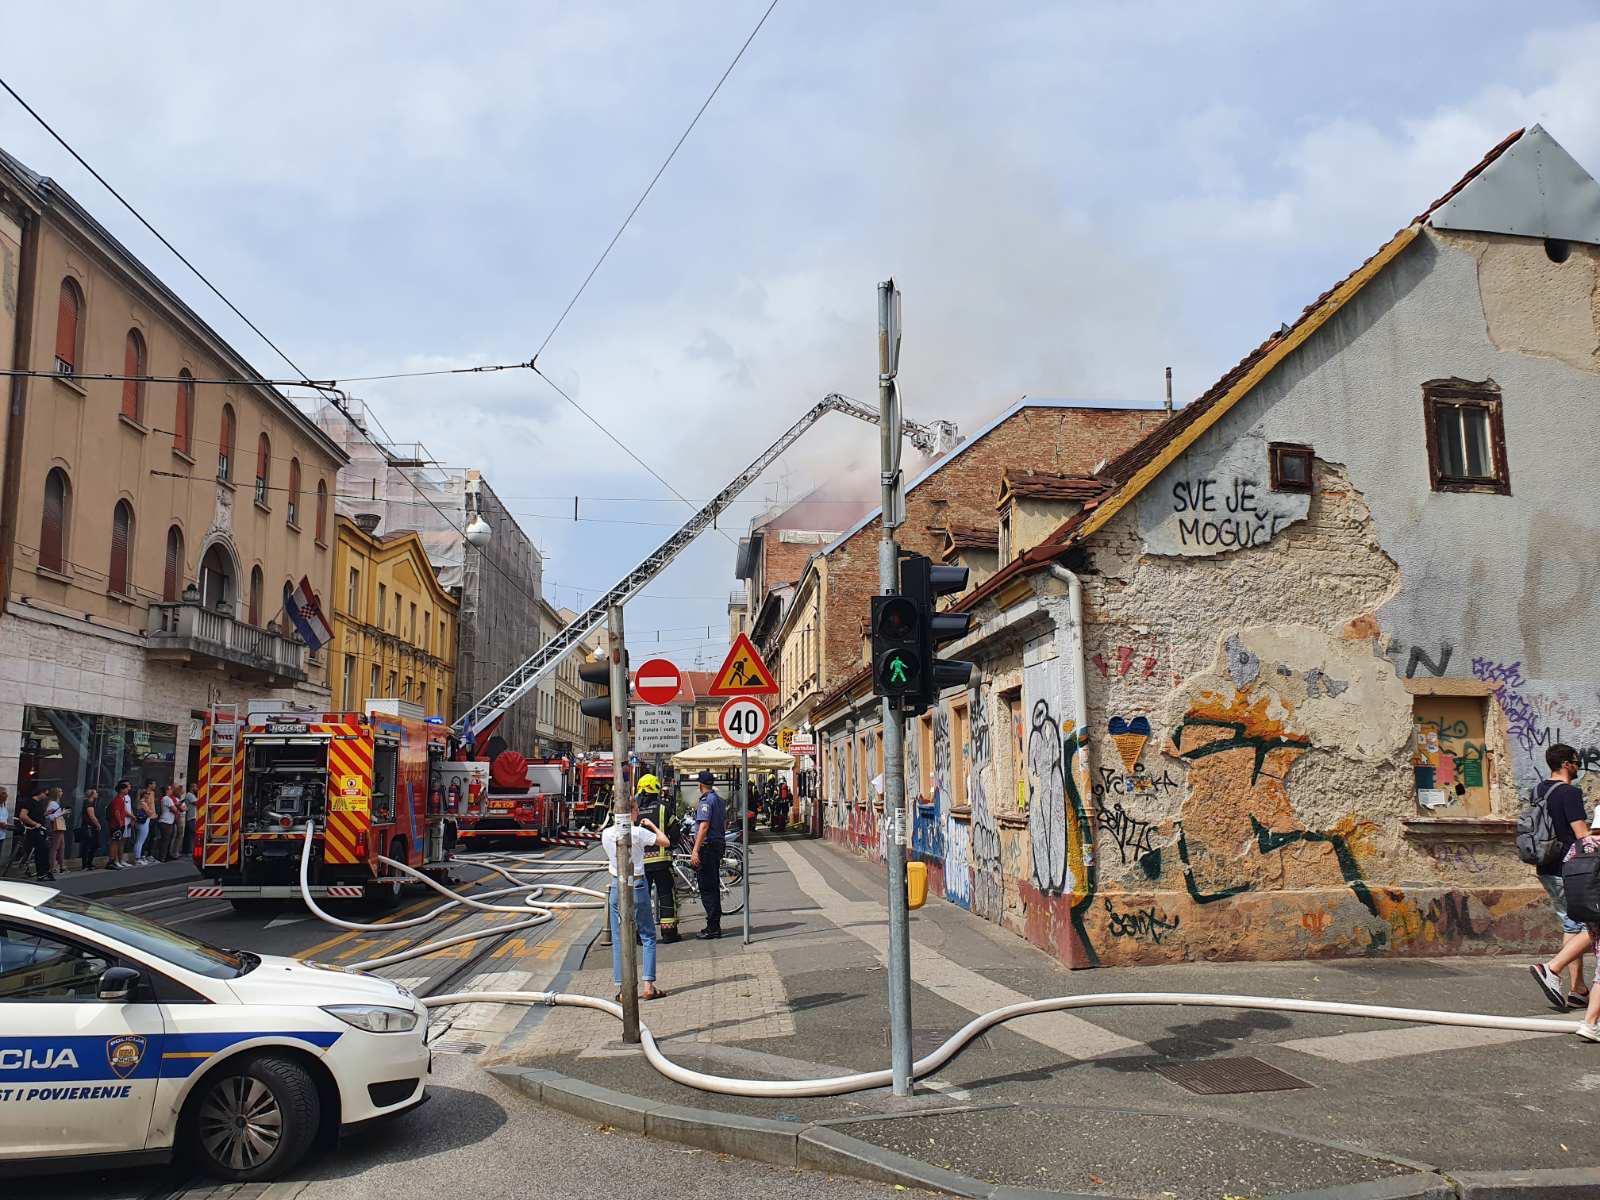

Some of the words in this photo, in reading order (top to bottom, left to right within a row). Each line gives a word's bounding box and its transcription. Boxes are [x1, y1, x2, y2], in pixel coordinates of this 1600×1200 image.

[1173, 479, 1216, 512] SVE
[1226, 478, 1258, 513] JE
[729, 710, 758, 735] 40
[16, 1089, 24, 1101] I
[26, 1086, 132, 1101] POVJERENJE
